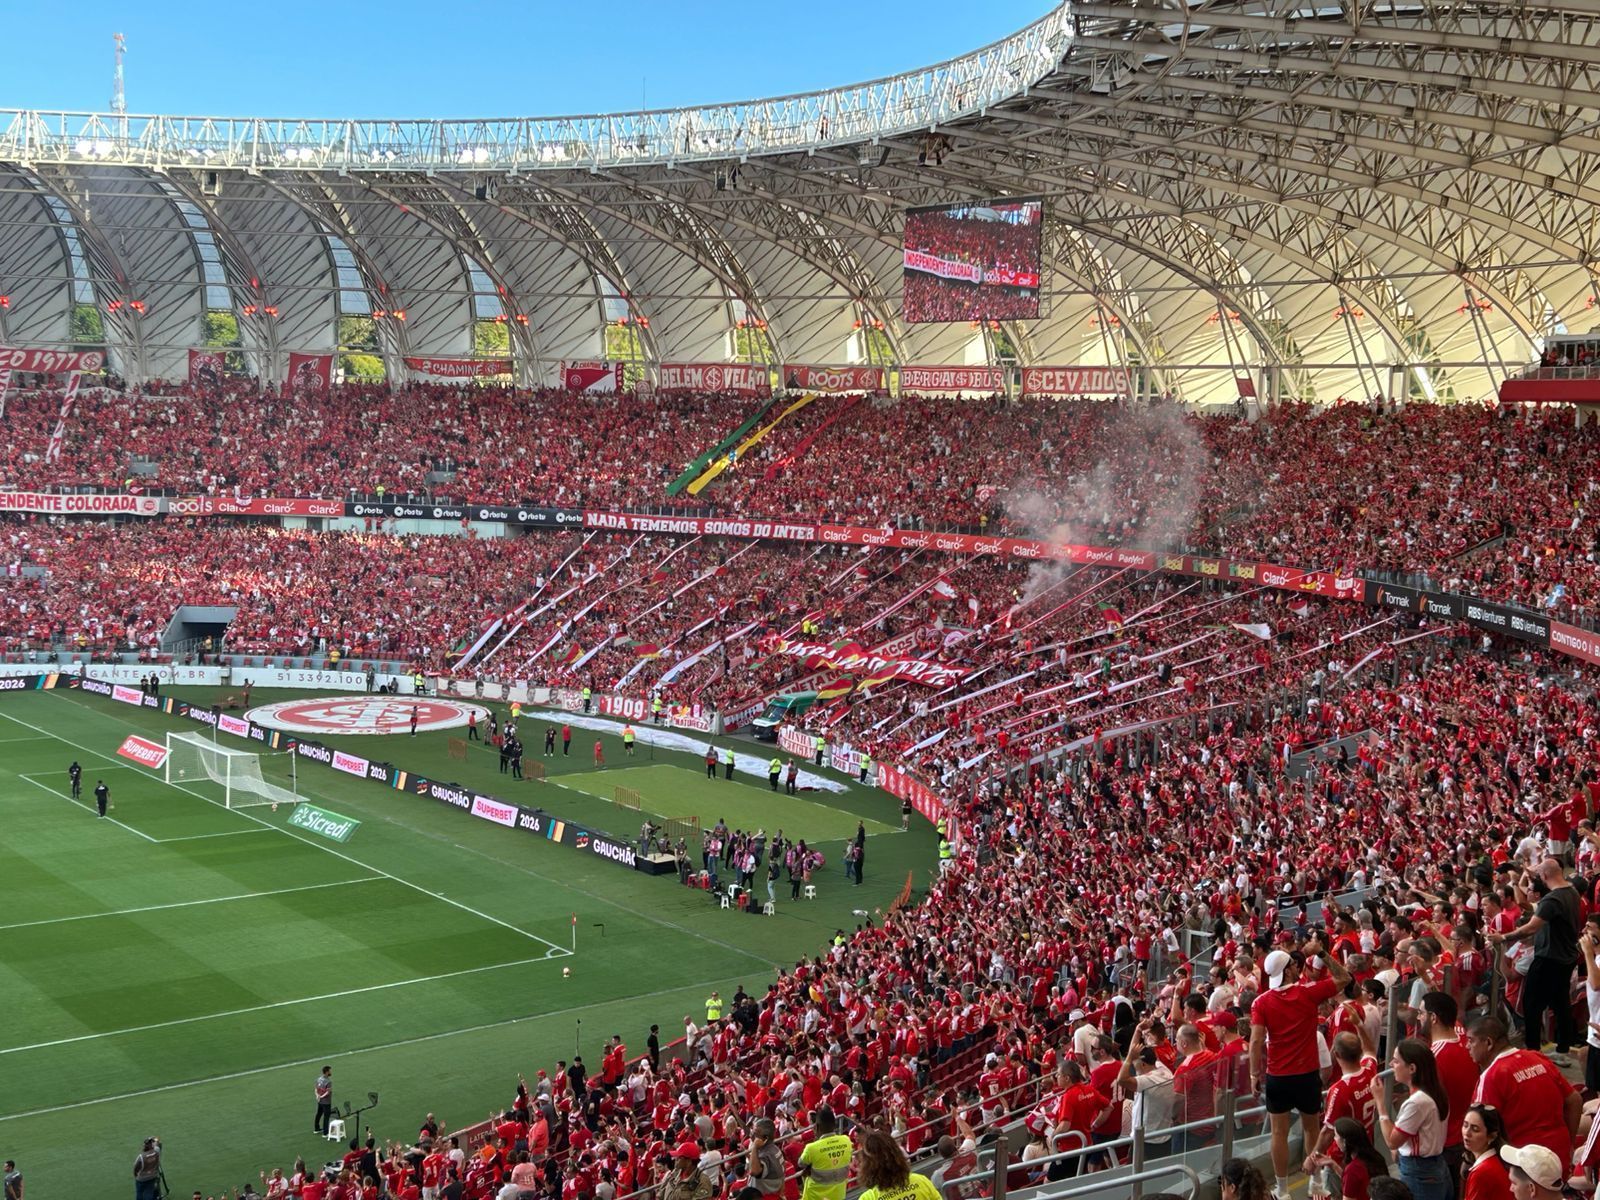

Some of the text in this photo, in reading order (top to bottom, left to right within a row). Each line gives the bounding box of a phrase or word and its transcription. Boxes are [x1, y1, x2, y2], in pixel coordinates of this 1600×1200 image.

[31, 352, 79, 372] 1977
[808, 371, 853, 390] ROOTS
[1041, 370, 1128, 392] CEVADOS
[65, 496, 137, 512] COLORADA
[264, 503, 293, 514] Claro
[308, 504, 338, 515] Claro
[587, 513, 628, 529] NADA
[704, 520, 750, 537] SOMOS
[753, 524, 771, 538] DO
[773, 526, 815, 541] INTER
[824, 531, 848, 541] Claro
[862, 533, 888, 545] Claro
[901, 535, 925, 547] Claro
[936, 538, 961, 550] Claro
[1012, 545, 1038, 557] Claro
[1263, 571, 1287, 585] Claro
[1552, 630, 1581, 650] CONTIGO
[277, 673, 290, 681] 51
[0, 679, 26, 690] 2026
[605, 697, 644, 719] 1909
[251, 726, 265, 741] 2026
[123, 738, 164, 763] SUPERBET
[299, 743, 387, 781] GAUCHÃO SUPERBET 2026
[432, 784, 540, 832] GAUCHÃO SUPERBET 2026
[1565, 809, 1572, 823] 5
[303, 809, 350, 840] Sicredi
[828, 1150, 845, 1159] 1607
